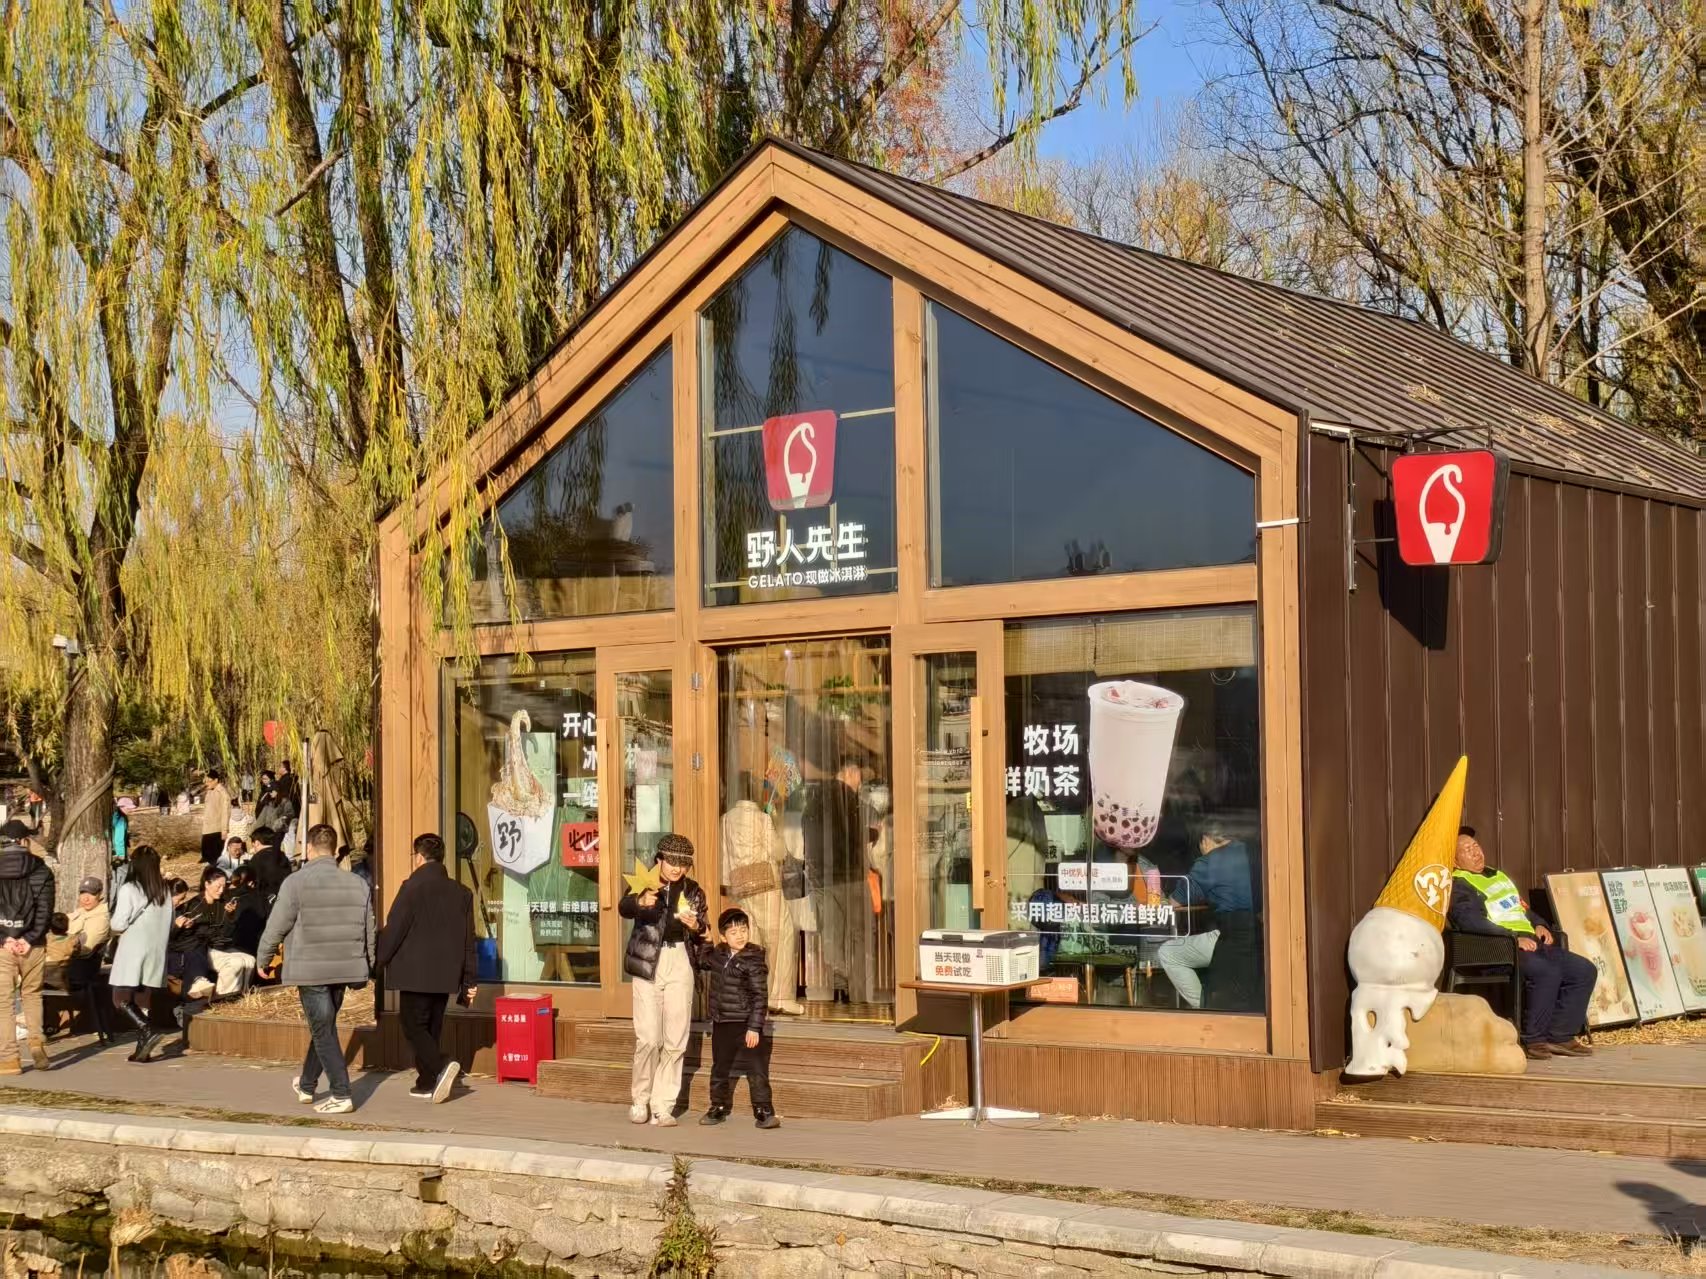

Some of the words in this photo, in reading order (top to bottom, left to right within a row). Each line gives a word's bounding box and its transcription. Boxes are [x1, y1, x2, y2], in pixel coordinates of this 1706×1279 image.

[747, 522, 865, 568] 野人先生
[748, 571, 803, 589] GELATO
[806, 566, 867, 585] 现做冰淇淋
[562, 712, 597, 737] 开心
[1024, 724, 1079, 755] 牧场
[497, 820, 521, 858] 野
[1011, 902, 1176, 925] 采用超欧盟标准鲜奶
[934, 951, 971, 964] 当天现做
[935, 965, 972, 978] 免费试吃
